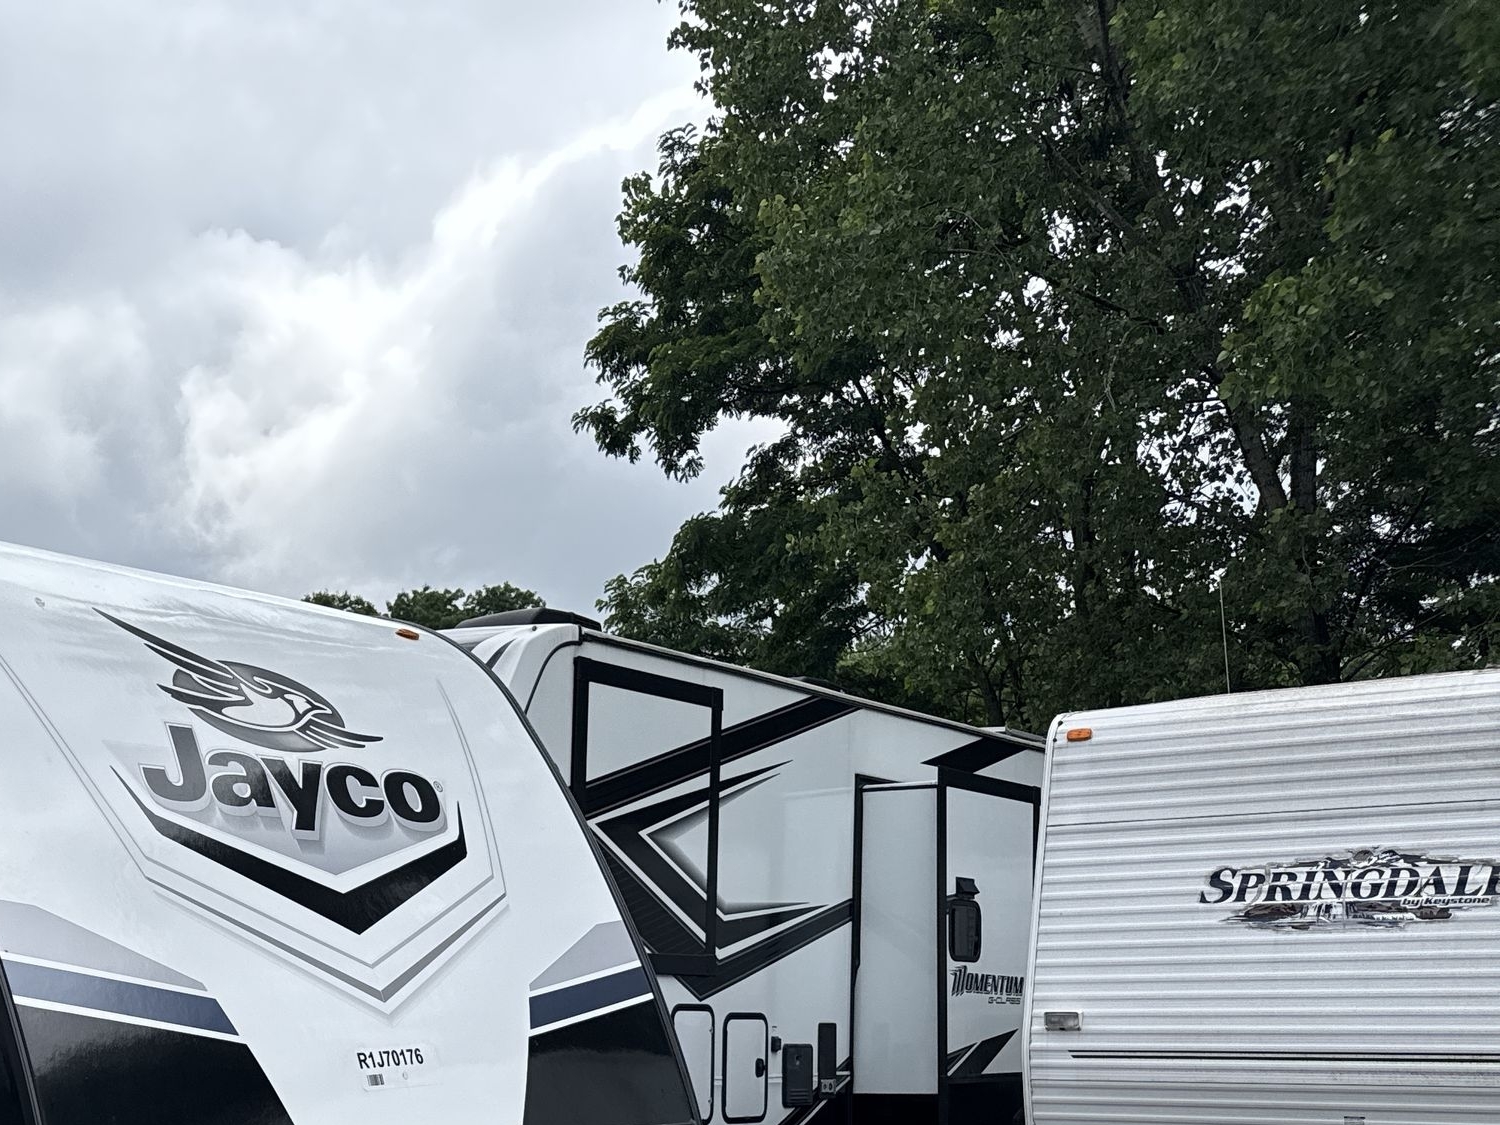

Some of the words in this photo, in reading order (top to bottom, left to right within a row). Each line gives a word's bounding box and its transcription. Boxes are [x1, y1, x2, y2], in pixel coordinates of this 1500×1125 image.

[140, 723, 443, 834] Jayco
[1401, 897, 1422, 908] by
[1424, 896, 1490, 907] Keystone
[949, 965, 1025, 996] MOMENTUM
[356, 1047, 424, 1070] R1J70176
